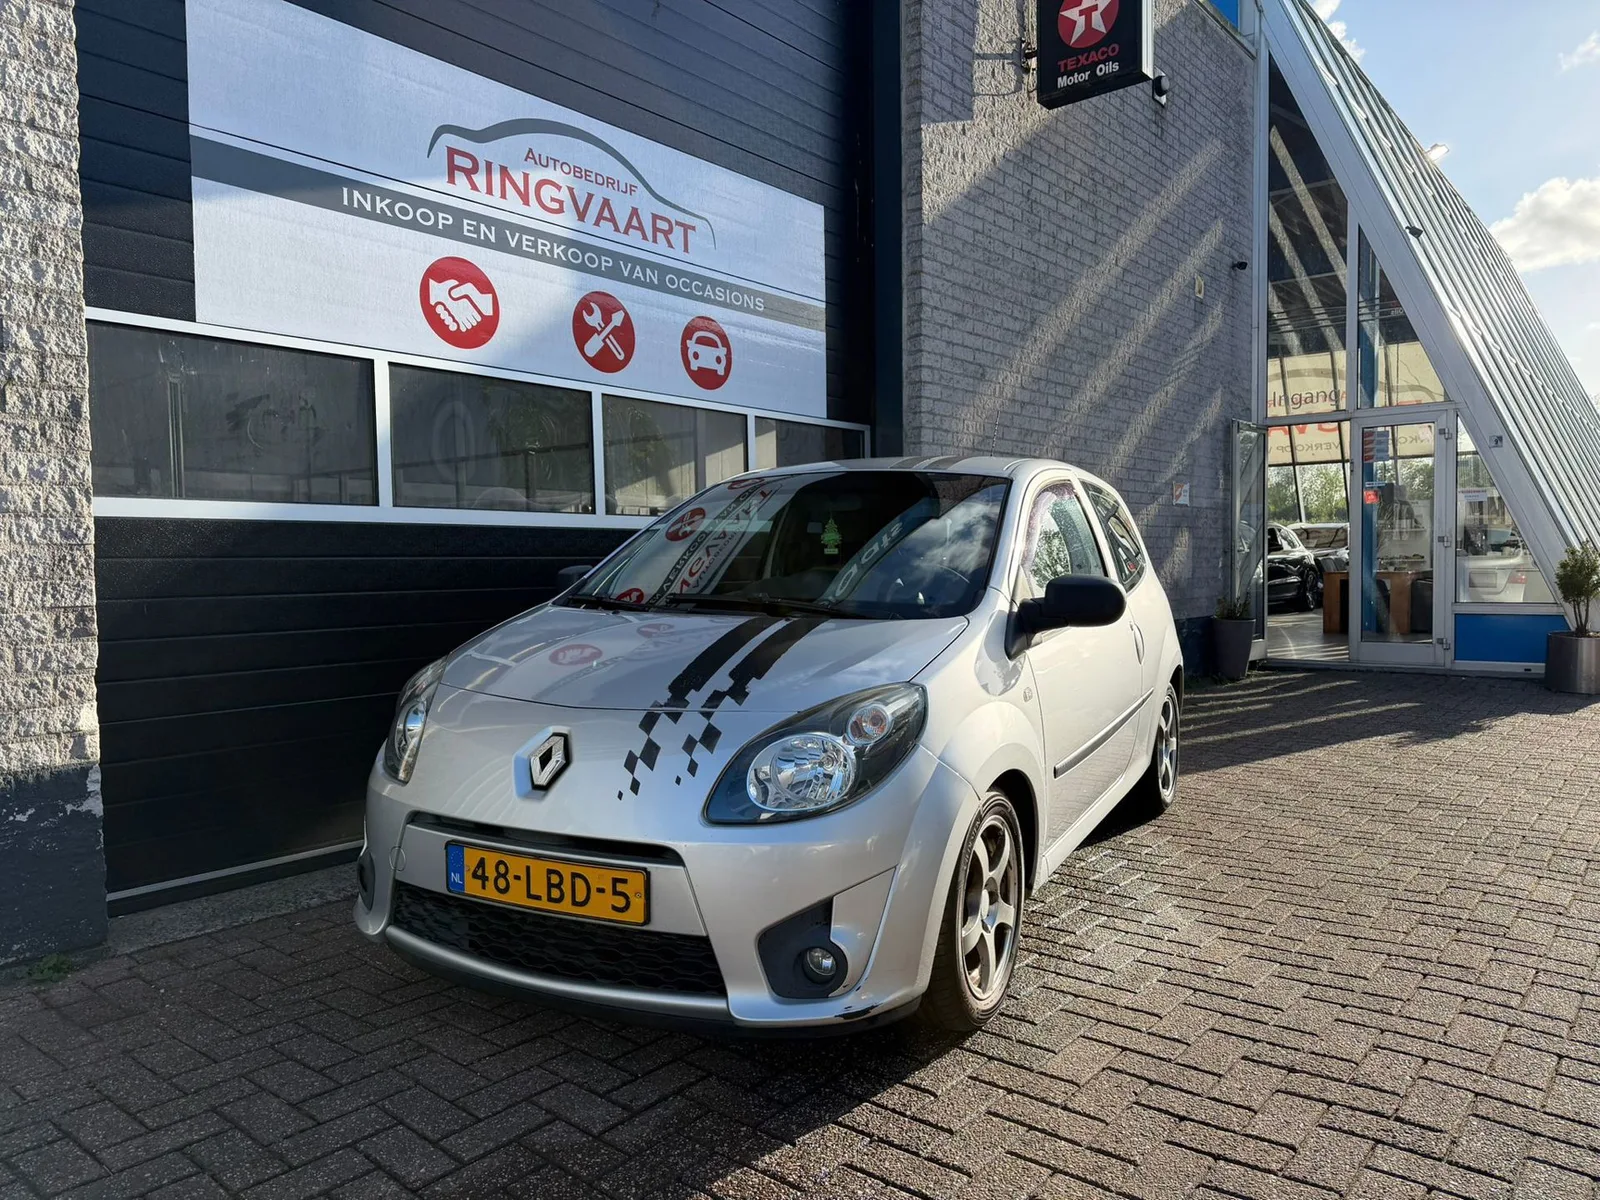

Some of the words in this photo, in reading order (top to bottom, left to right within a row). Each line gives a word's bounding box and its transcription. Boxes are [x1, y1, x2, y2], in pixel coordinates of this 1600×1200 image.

[1057, 43, 1120, 73] TEXACO
[1057, 70, 1091, 89] Motor
[1096, 60, 1120, 77] Oils
[524, 147, 638, 197] AUTOBEDRIJF
[445, 145, 697, 254] RINGVAART
[342, 186, 454, 230] INKOOP
[463, 218, 497, 243] EN
[505, 229, 613, 272] VERKOOP
[619, 260, 659, 285] VAN
[665, 274, 765, 312] OCCASIONS
[1272, 388, 1341, 410] Ingang
[450, 872, 463, 884] NL
[471, 856, 631, 914] 48-LBD-5
